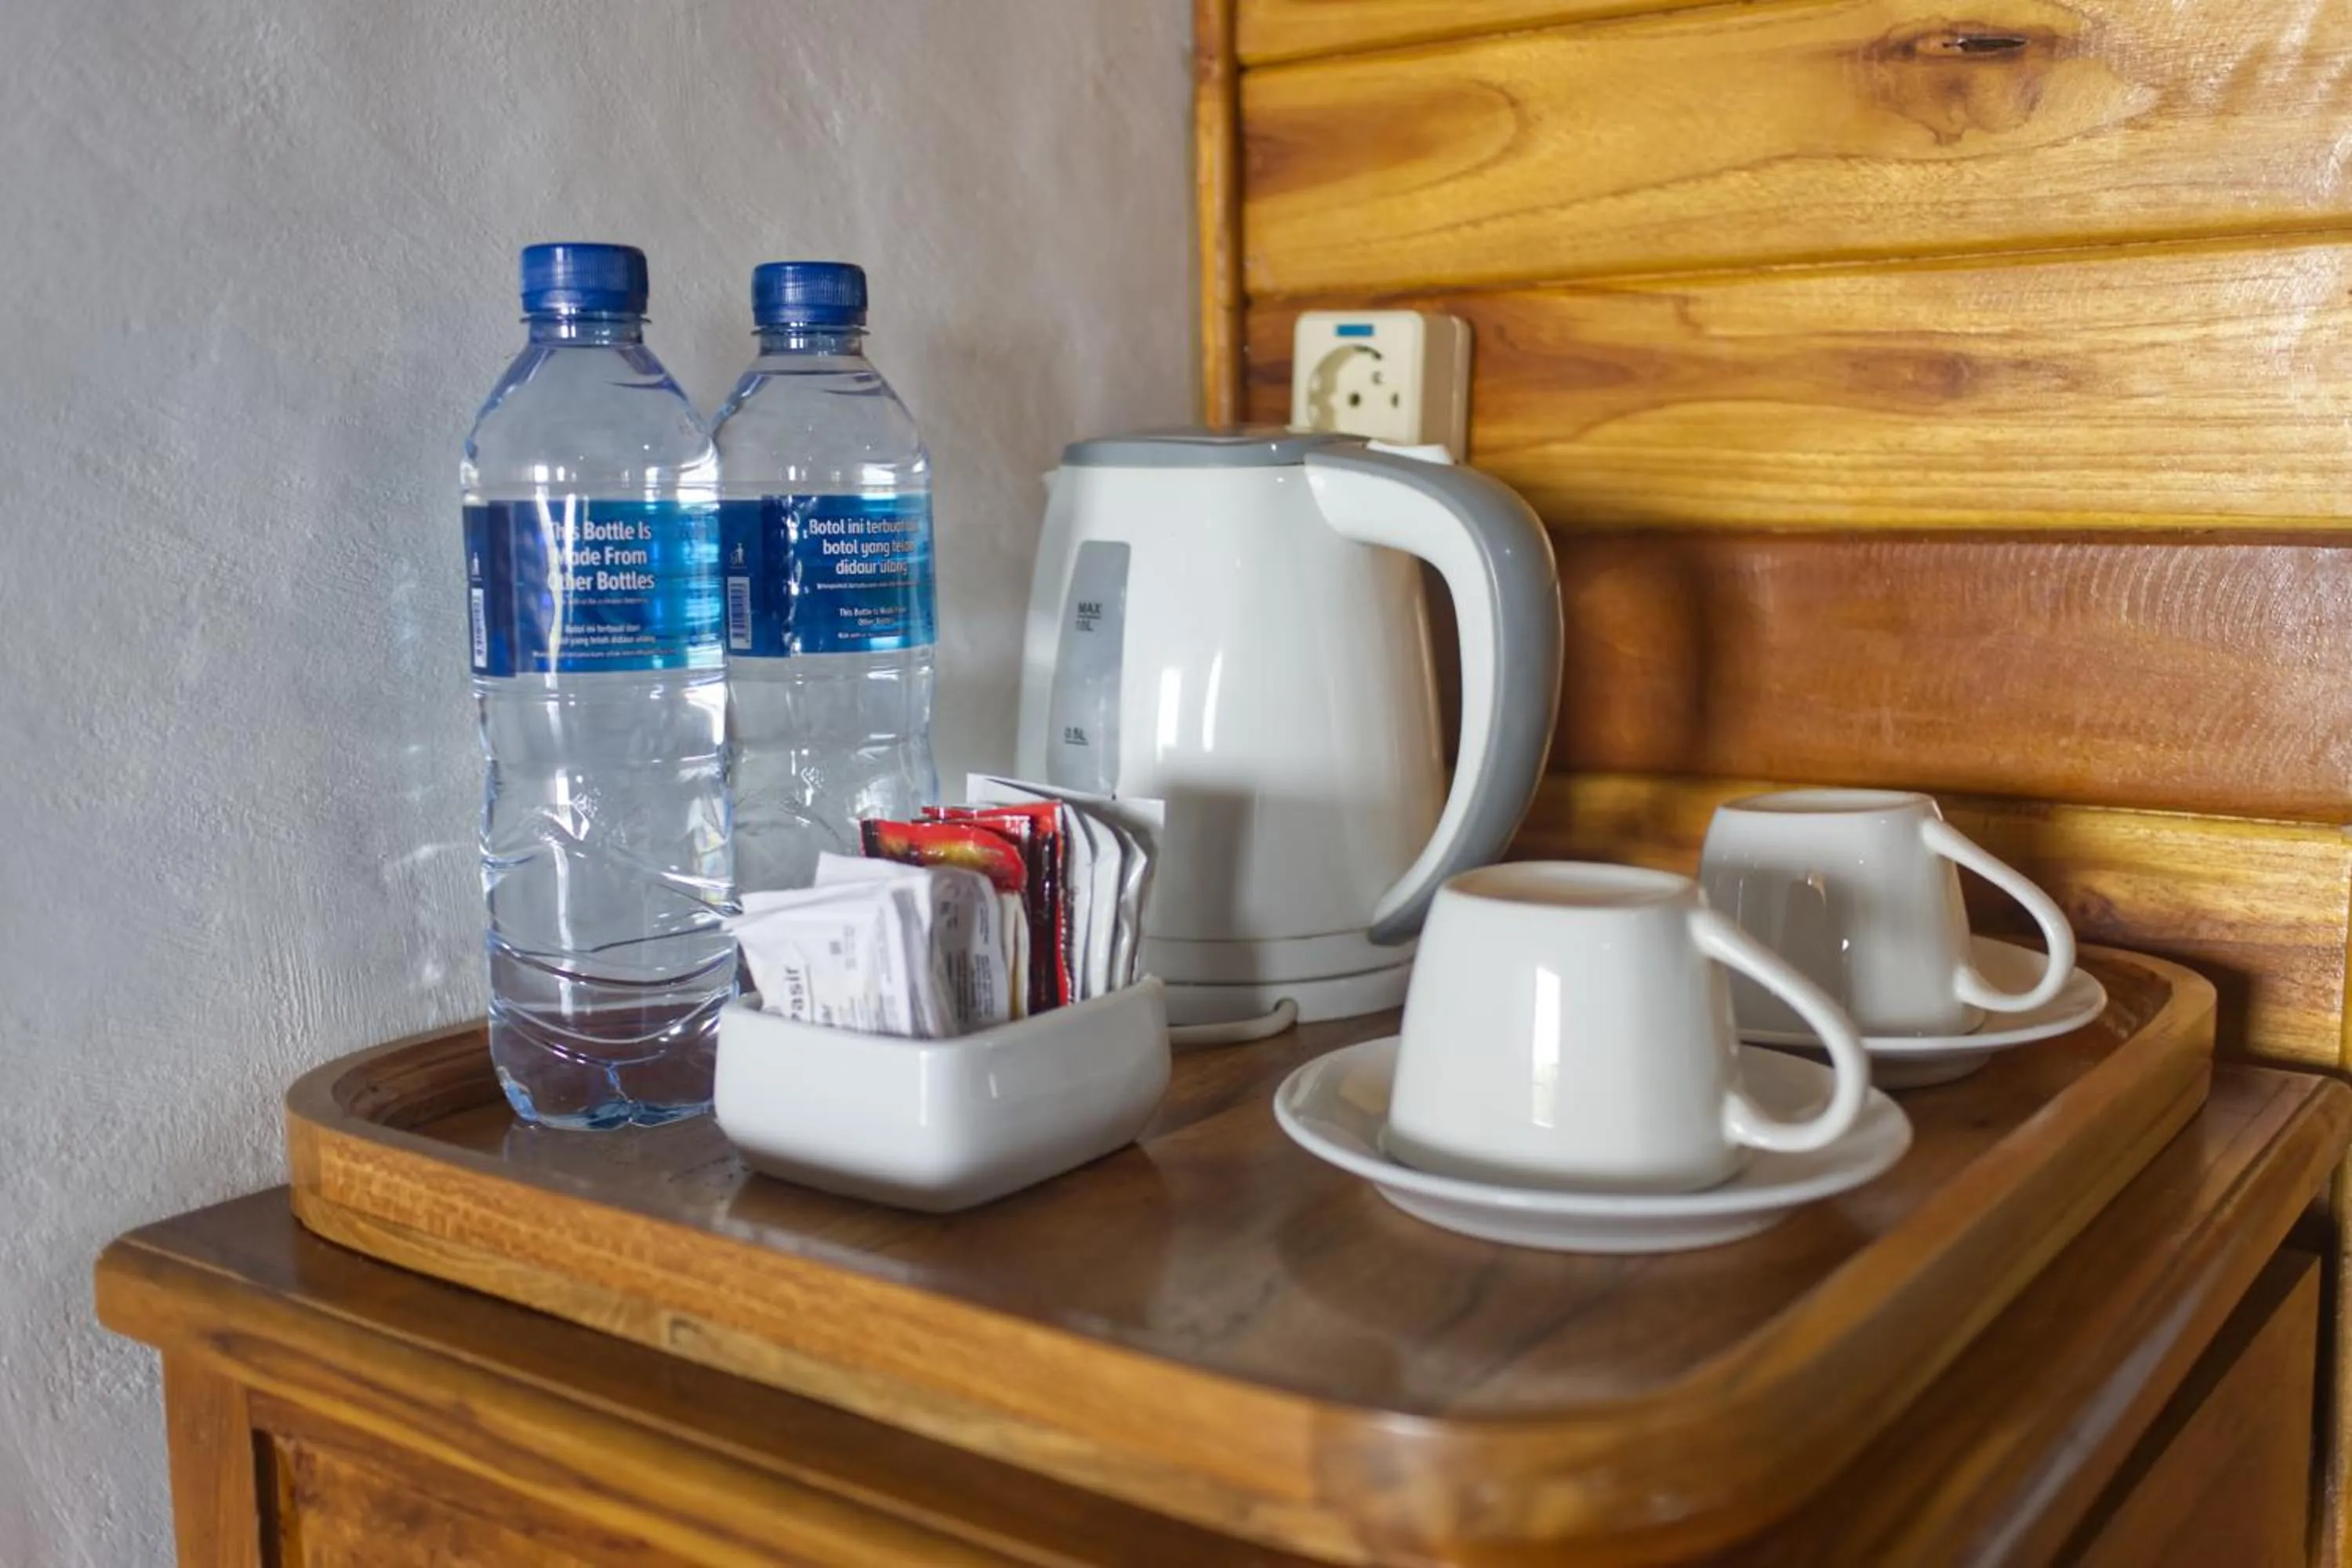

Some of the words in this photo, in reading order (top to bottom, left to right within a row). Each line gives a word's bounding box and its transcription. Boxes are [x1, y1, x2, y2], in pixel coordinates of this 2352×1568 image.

[550, 521, 580, 540] hs
[583, 520, 634, 540] Bottle
[638, 521, 652, 540] Is
[808, 518, 846, 535] Botol
[848, 517, 863, 534] ini
[604, 546, 647, 565] From
[822, 539, 858, 555] botol
[860, 541, 890, 558] yang
[836, 558, 876, 575] didaur
[597, 570, 655, 590] Bottles
[1078, 602, 1102, 615] MAX
